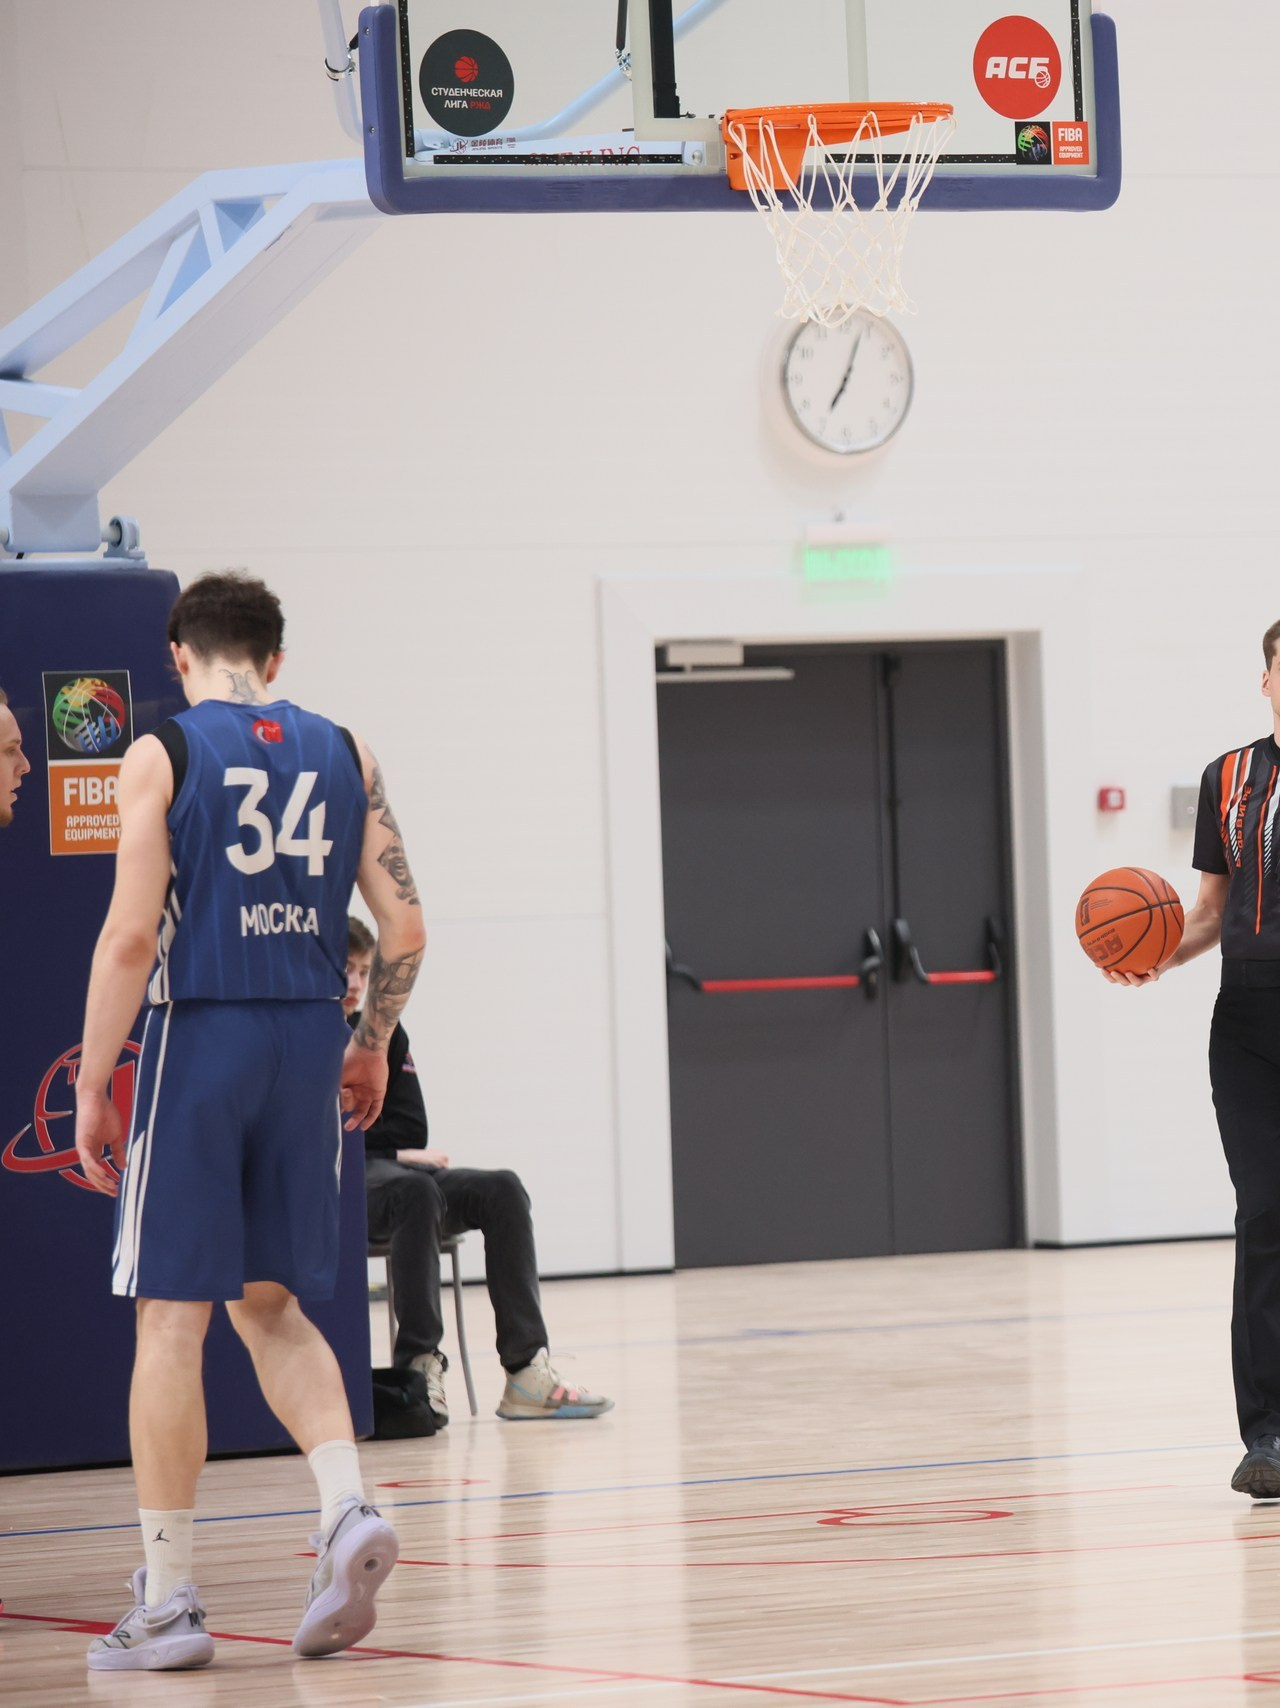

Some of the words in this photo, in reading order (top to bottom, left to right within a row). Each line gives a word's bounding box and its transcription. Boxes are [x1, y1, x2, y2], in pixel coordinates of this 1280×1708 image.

[985, 56, 1050, 80] АСБ
[431, 86, 503, 98] СТУДЕНЧЕСКАЯ
[444, 99, 469, 109] ЛИГА
[469, 100, 492, 110] РЖД
[1058, 127, 1083, 142] FIBA
[63, 776, 120, 807] FIBA
[66, 814, 120, 828] APPROVED
[223, 767, 334, 877] 34
[64, 827, 122, 842] EQUIPMENT
